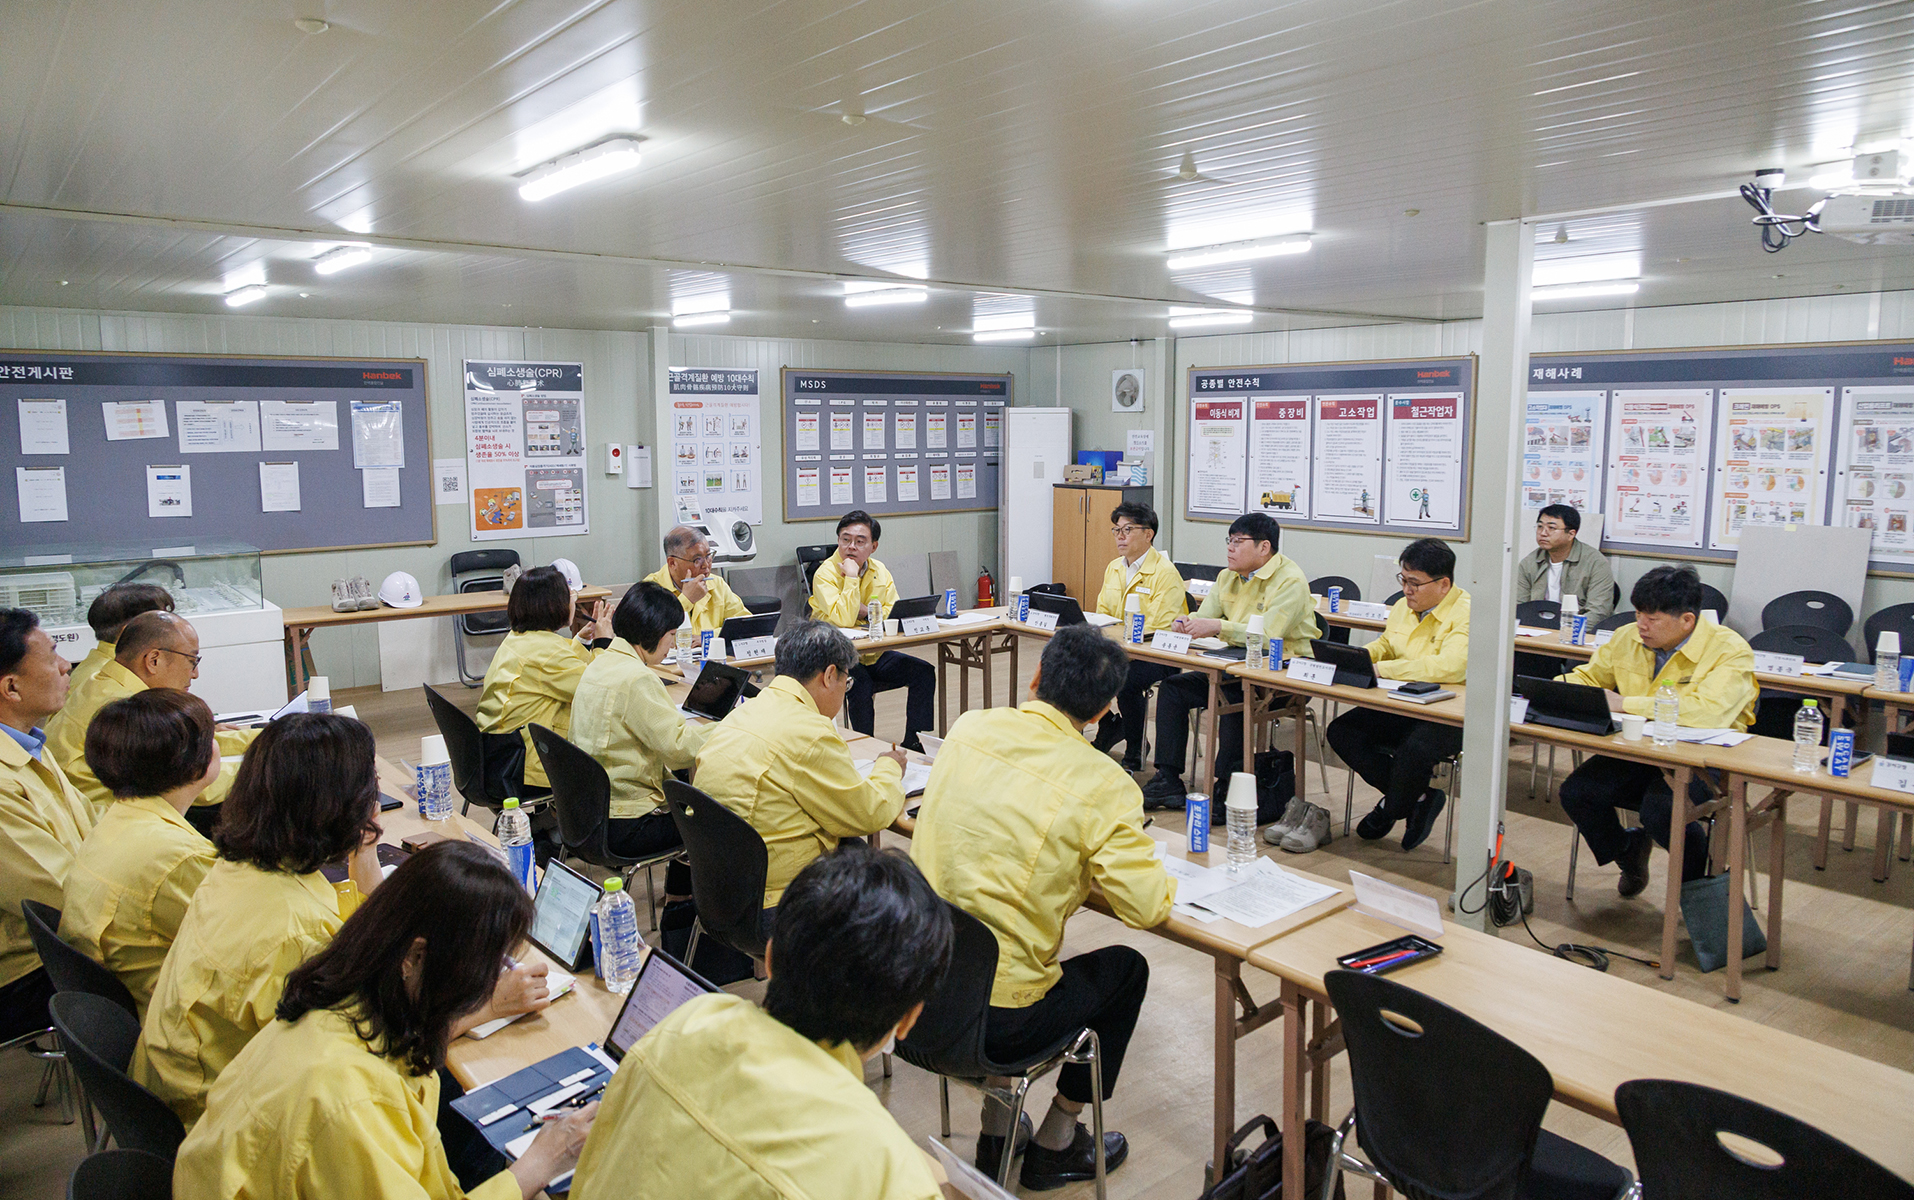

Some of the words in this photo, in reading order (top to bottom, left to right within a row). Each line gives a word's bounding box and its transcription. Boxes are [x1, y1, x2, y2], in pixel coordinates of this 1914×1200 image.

[0, 365, 74, 380] 안전게시판
[362, 371, 402, 380] Hanbek
[486, 366, 563, 378] 심폐소생술(CPR)
[1532, 367, 1582, 380] 재해사례
[710, 373, 724, 383] 예방
[727, 374, 755, 384] 10대수칙
[800, 380, 826, 389] MSDS
[1200, 379, 1224, 389] 공종별
[1227, 377, 1260, 389] 안전수칙
[1209, 408, 1227, 419] 이동식
[1228, 408, 1240, 418] 비계
[1278, 407, 1304, 419] 중장비
[1338, 406, 1375, 418] 고소작업
[1411, 405, 1453, 418] 철근작업자
[1834, 735, 1845, 771] SWEAT
[1840, 735, 1852, 776] POCARI
